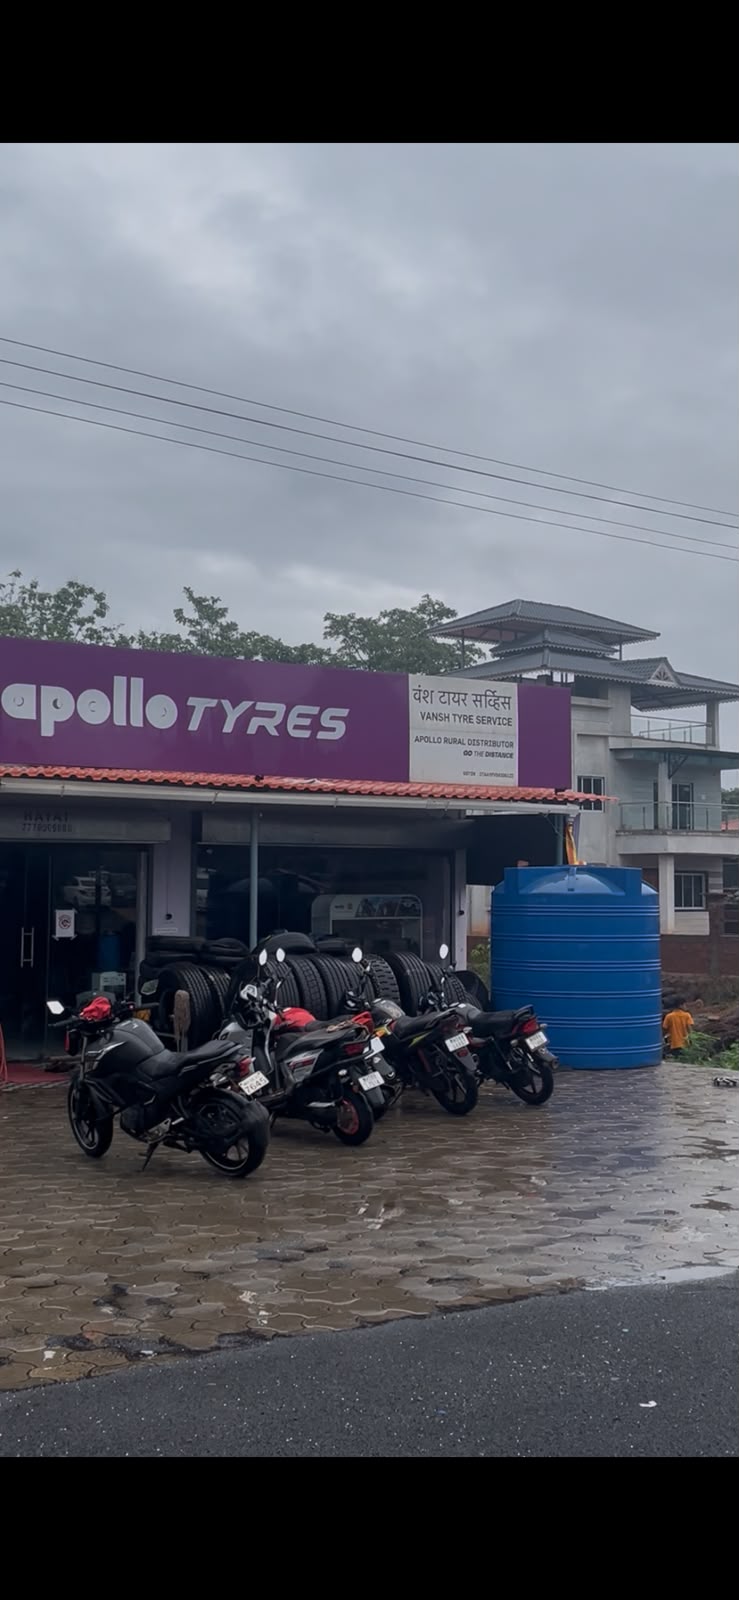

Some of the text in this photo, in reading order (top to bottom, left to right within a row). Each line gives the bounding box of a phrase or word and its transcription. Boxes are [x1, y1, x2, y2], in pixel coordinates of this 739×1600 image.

[412, 685, 434, 705] वंश
[438, 690, 468, 707] टायर
[1, 675, 350, 741] apollo TYRES
[420, 711, 513, 727] VANSH TYRE SERVICE
[414, 735, 514, 749] APOLLO RURAL DISTRIBUTOR
[485, 751, 514, 759] DISTANCE
[244, 1076, 267, 1093] 7645
